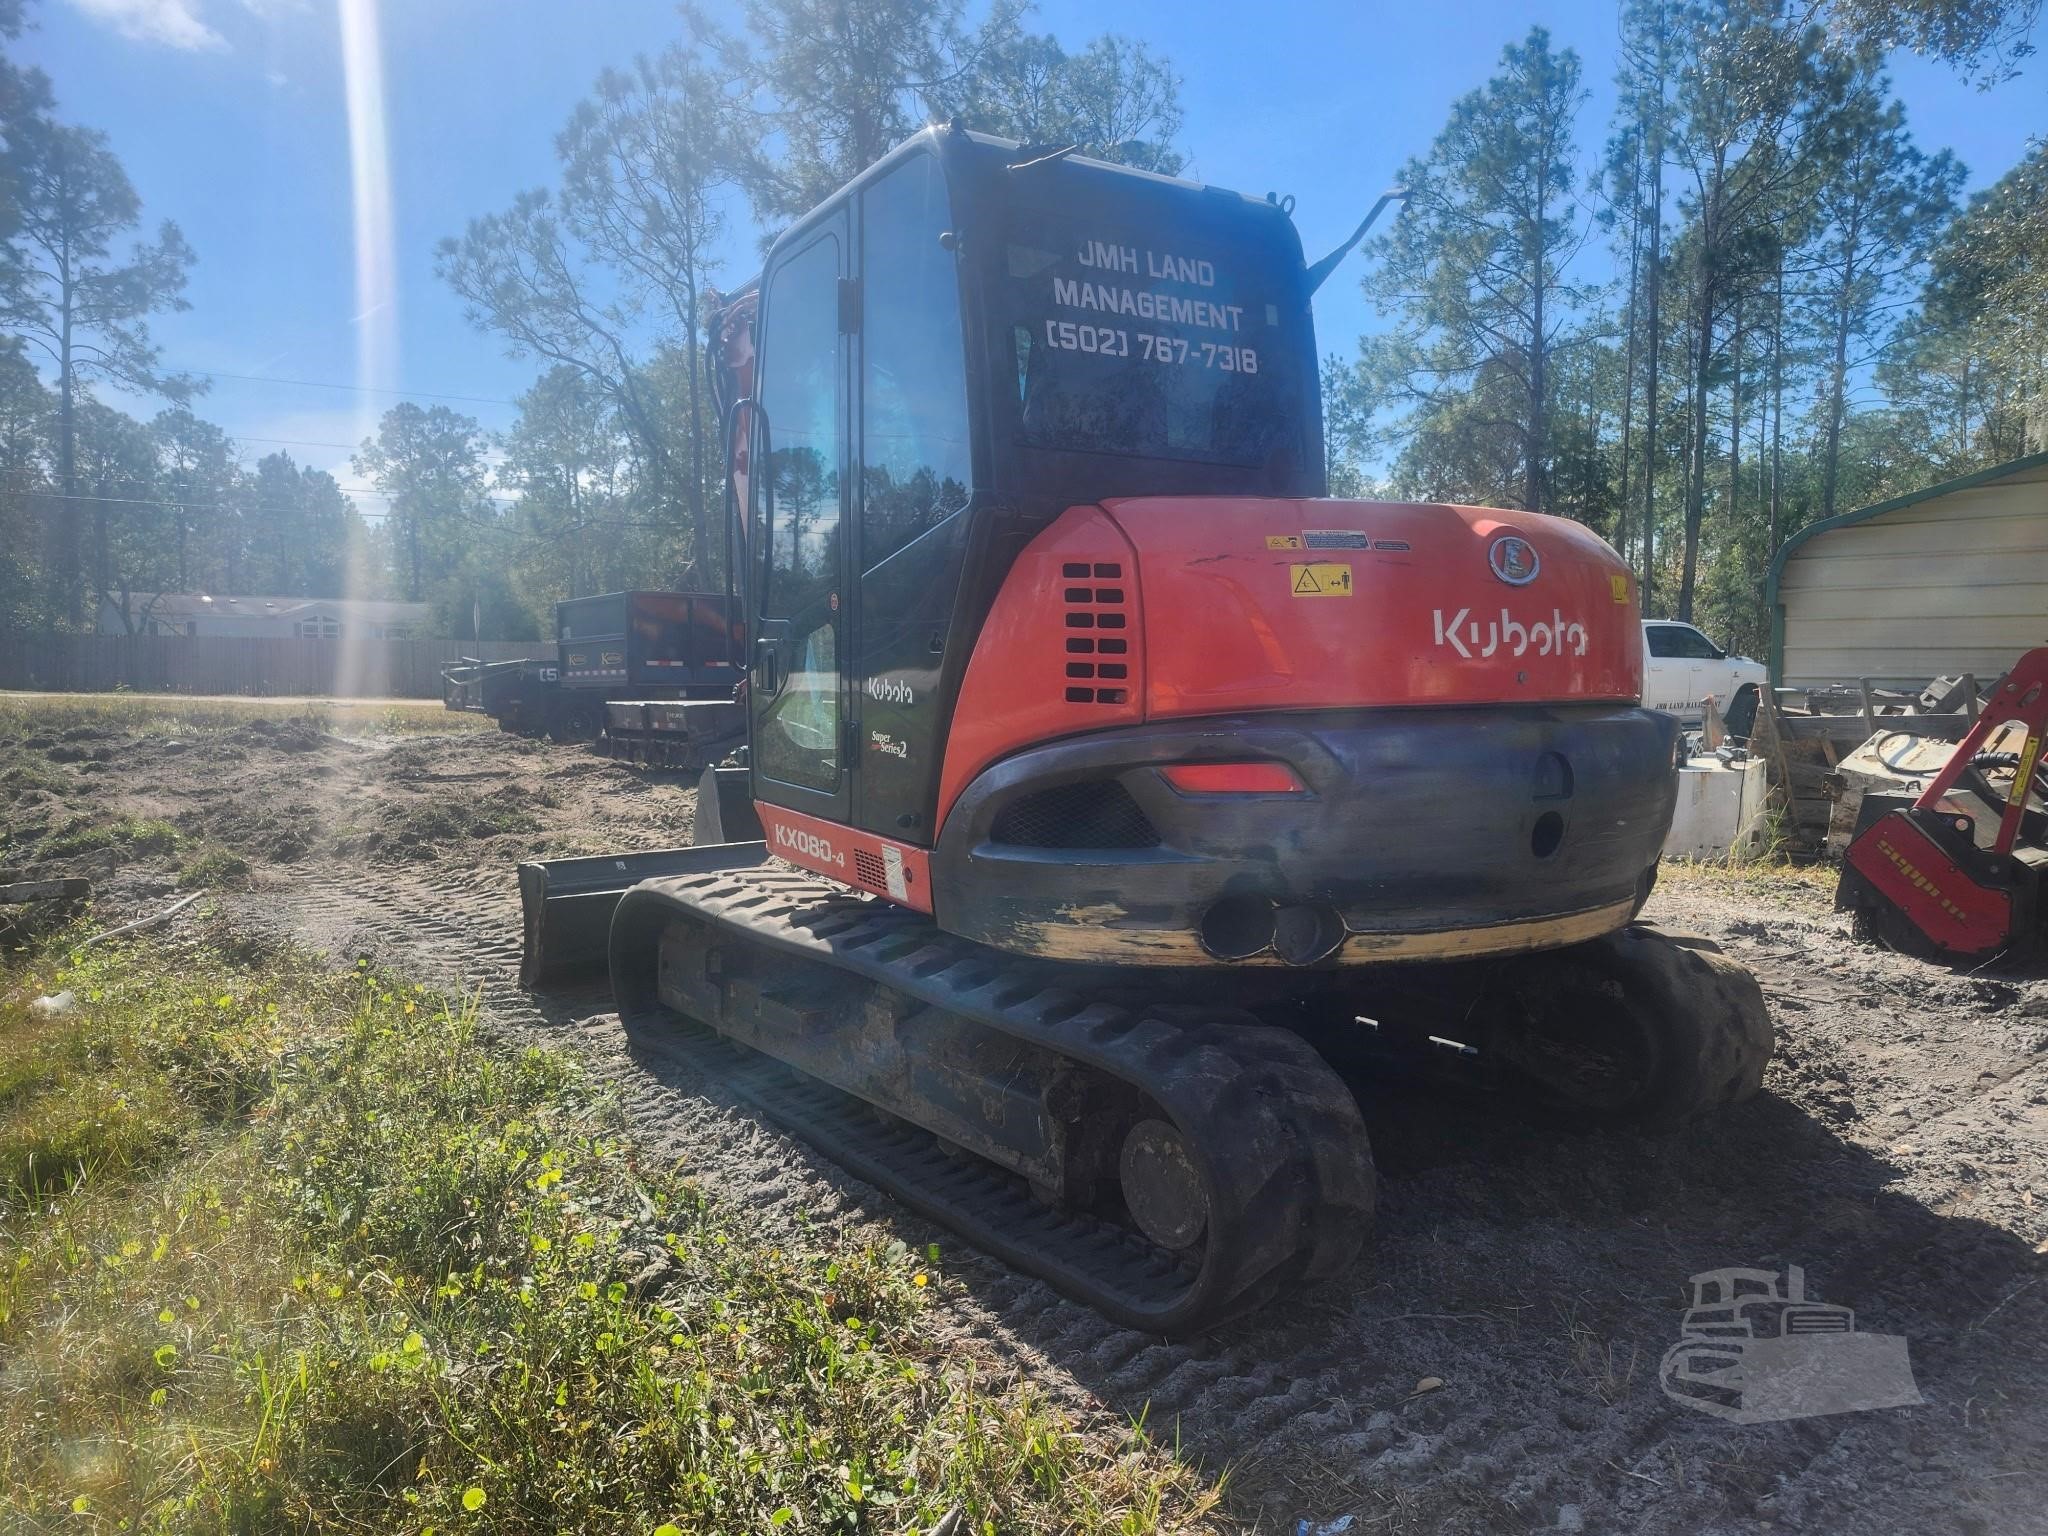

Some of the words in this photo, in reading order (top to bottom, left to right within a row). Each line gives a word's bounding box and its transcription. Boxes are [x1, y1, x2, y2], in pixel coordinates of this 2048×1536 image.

[1078, 240, 1138, 274] JMH
[1147, 251, 1215, 287] LAND
[1053, 277, 1243, 331] MANAGEMENT
[1137, 334, 1258, 374] 767-7318
[1432, 608, 1587, 658] Kubota
[868, 677, 913, 704] Kubota
[872, 730, 891, 744] Super
[775, 823, 845, 868] KX080-4
